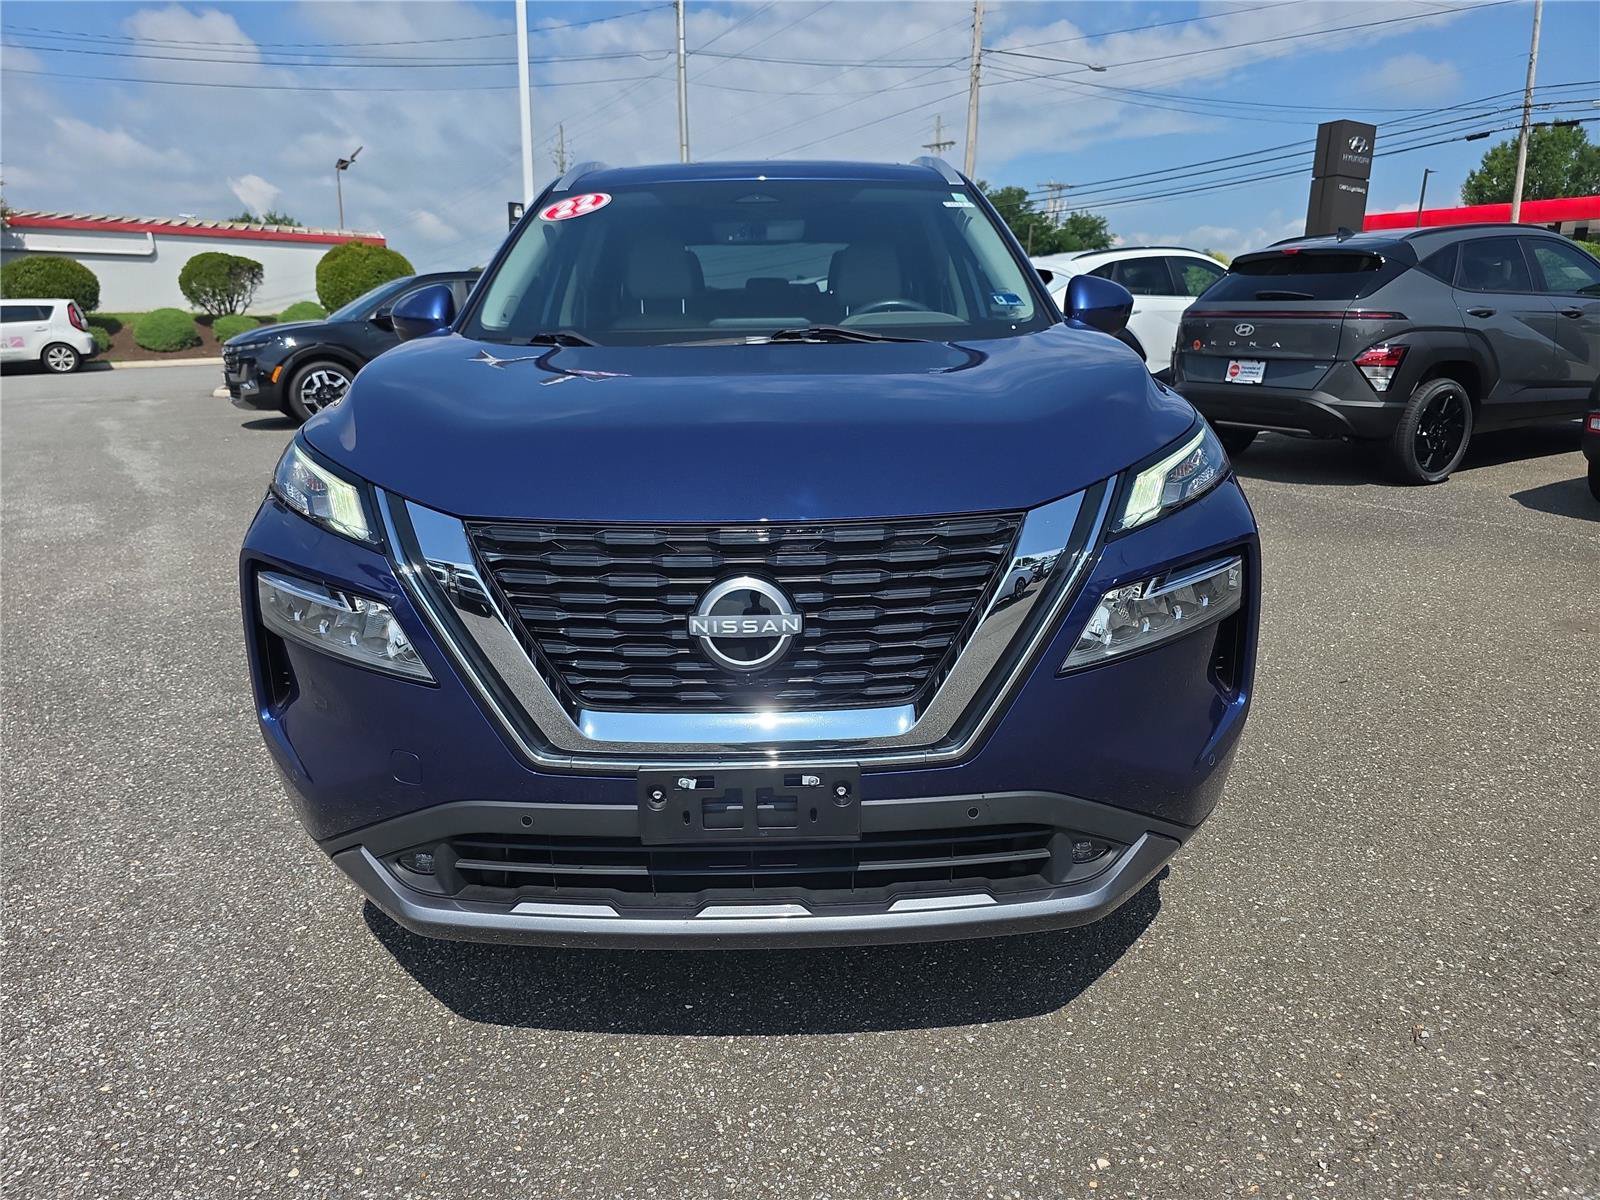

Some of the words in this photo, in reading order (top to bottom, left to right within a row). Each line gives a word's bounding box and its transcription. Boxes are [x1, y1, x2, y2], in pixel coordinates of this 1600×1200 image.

[551, 193, 599, 219] 22
[1210, 340, 1281, 348] KONA
[692, 618, 799, 633] NISSAN
